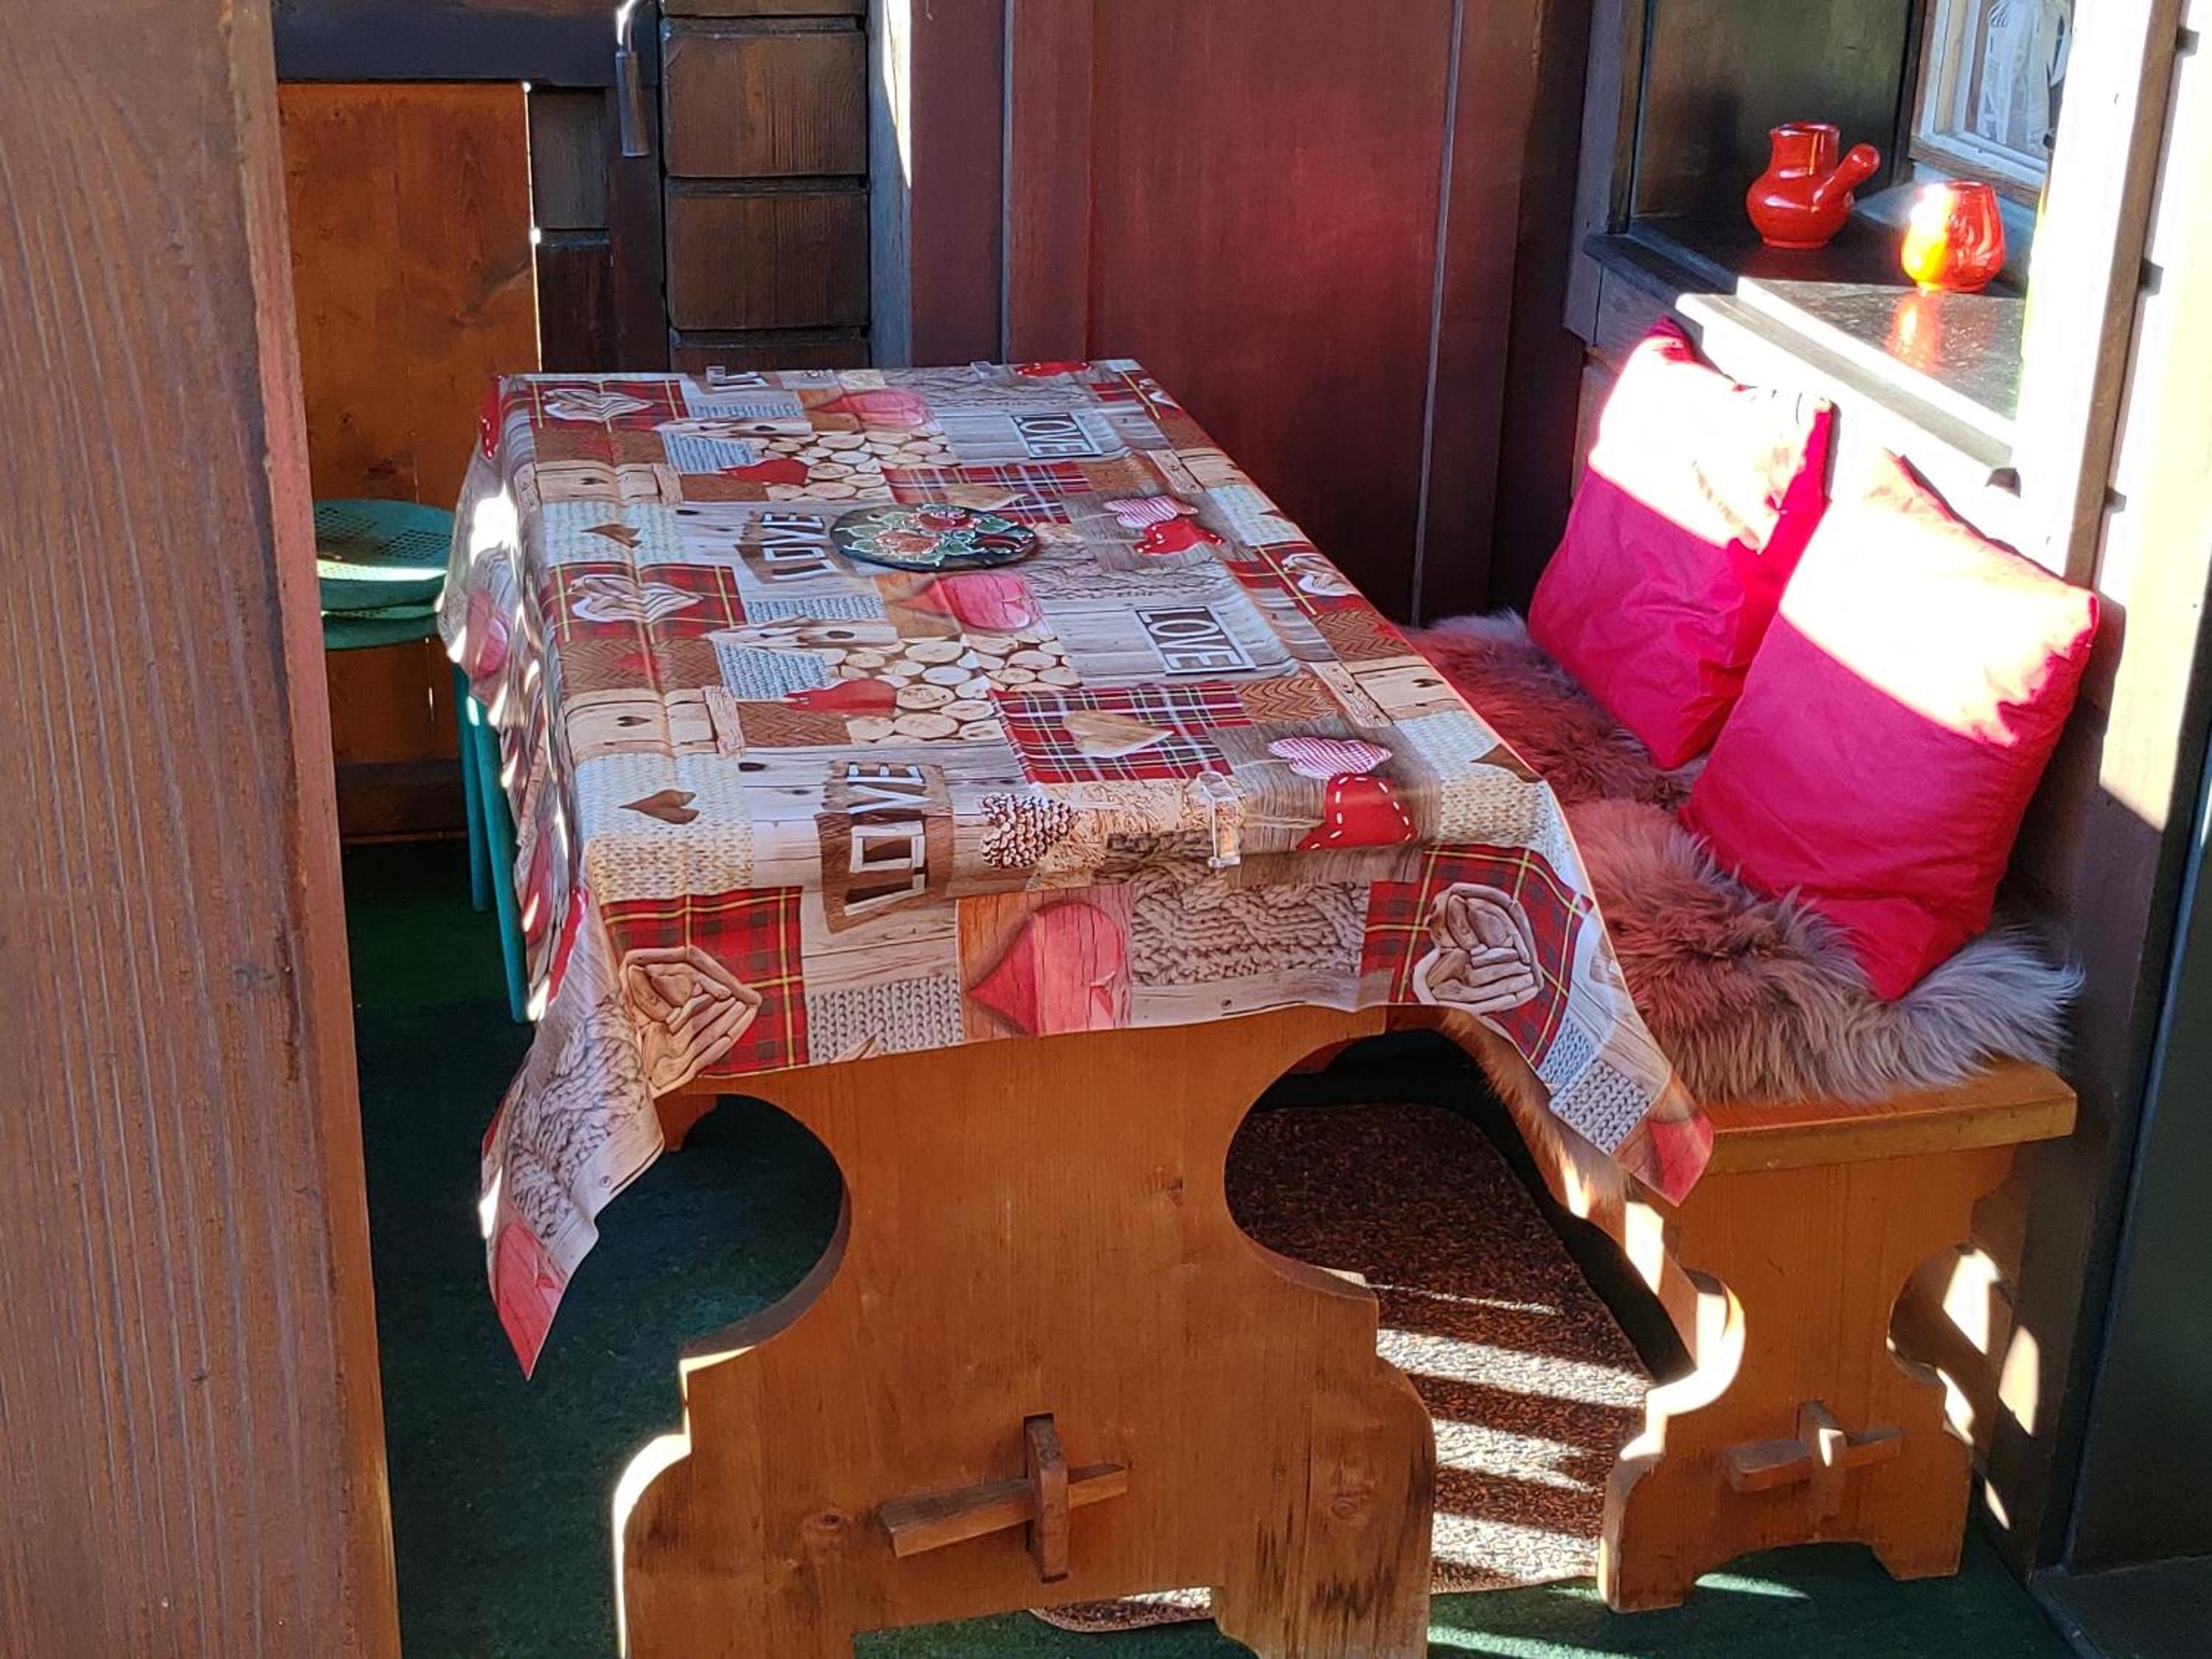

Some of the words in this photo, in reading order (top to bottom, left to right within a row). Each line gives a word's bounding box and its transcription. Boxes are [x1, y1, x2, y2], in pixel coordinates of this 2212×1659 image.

[1013, 414, 1093, 454] LOVE
[762, 514, 838, 580] LOVE
[1138, 608, 1244, 669] LOVE
[844, 764, 931, 917] LOVE
